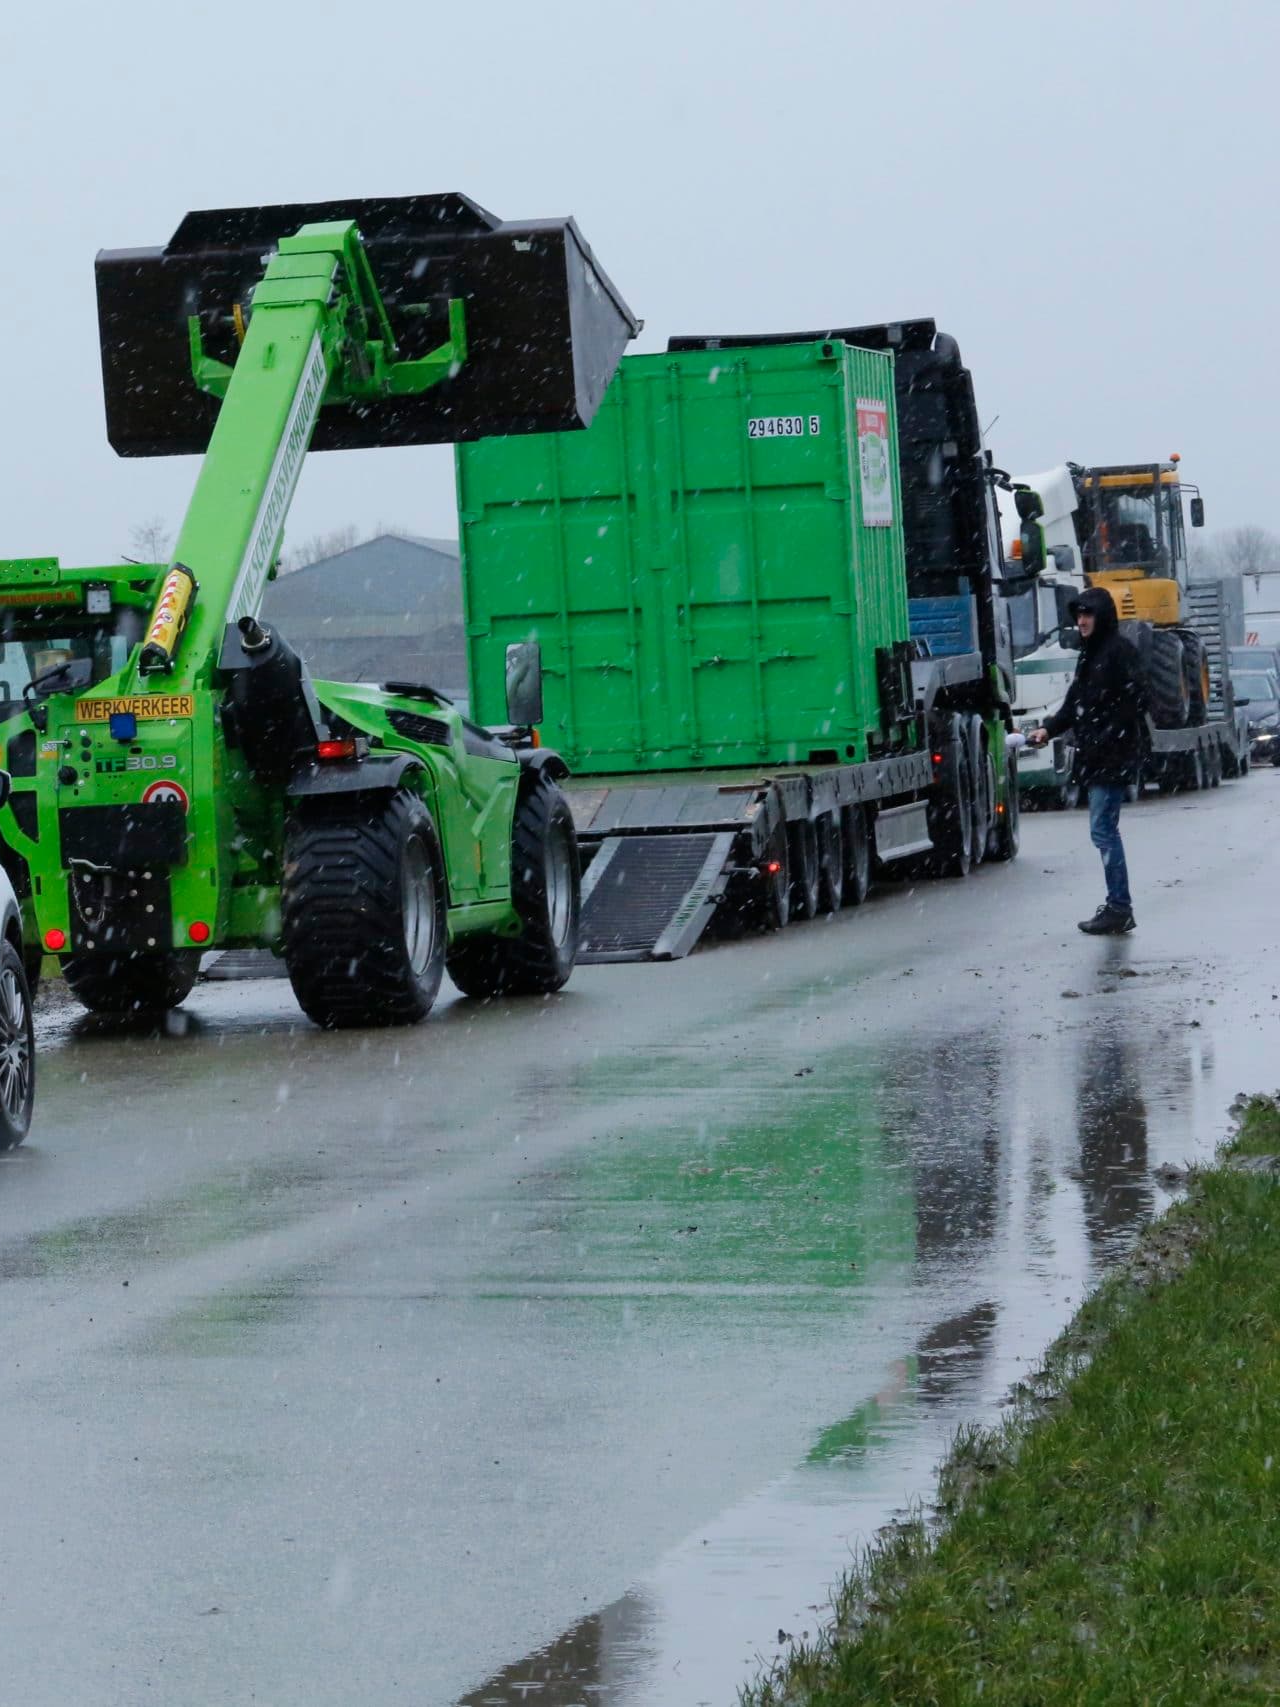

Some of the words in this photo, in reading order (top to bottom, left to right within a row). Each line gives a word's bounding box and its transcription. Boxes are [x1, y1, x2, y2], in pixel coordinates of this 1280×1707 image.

[749, 418, 802, 437] 294630
[810, 417, 818, 433] 5
[80, 697, 189, 719] WERKVERKEER
